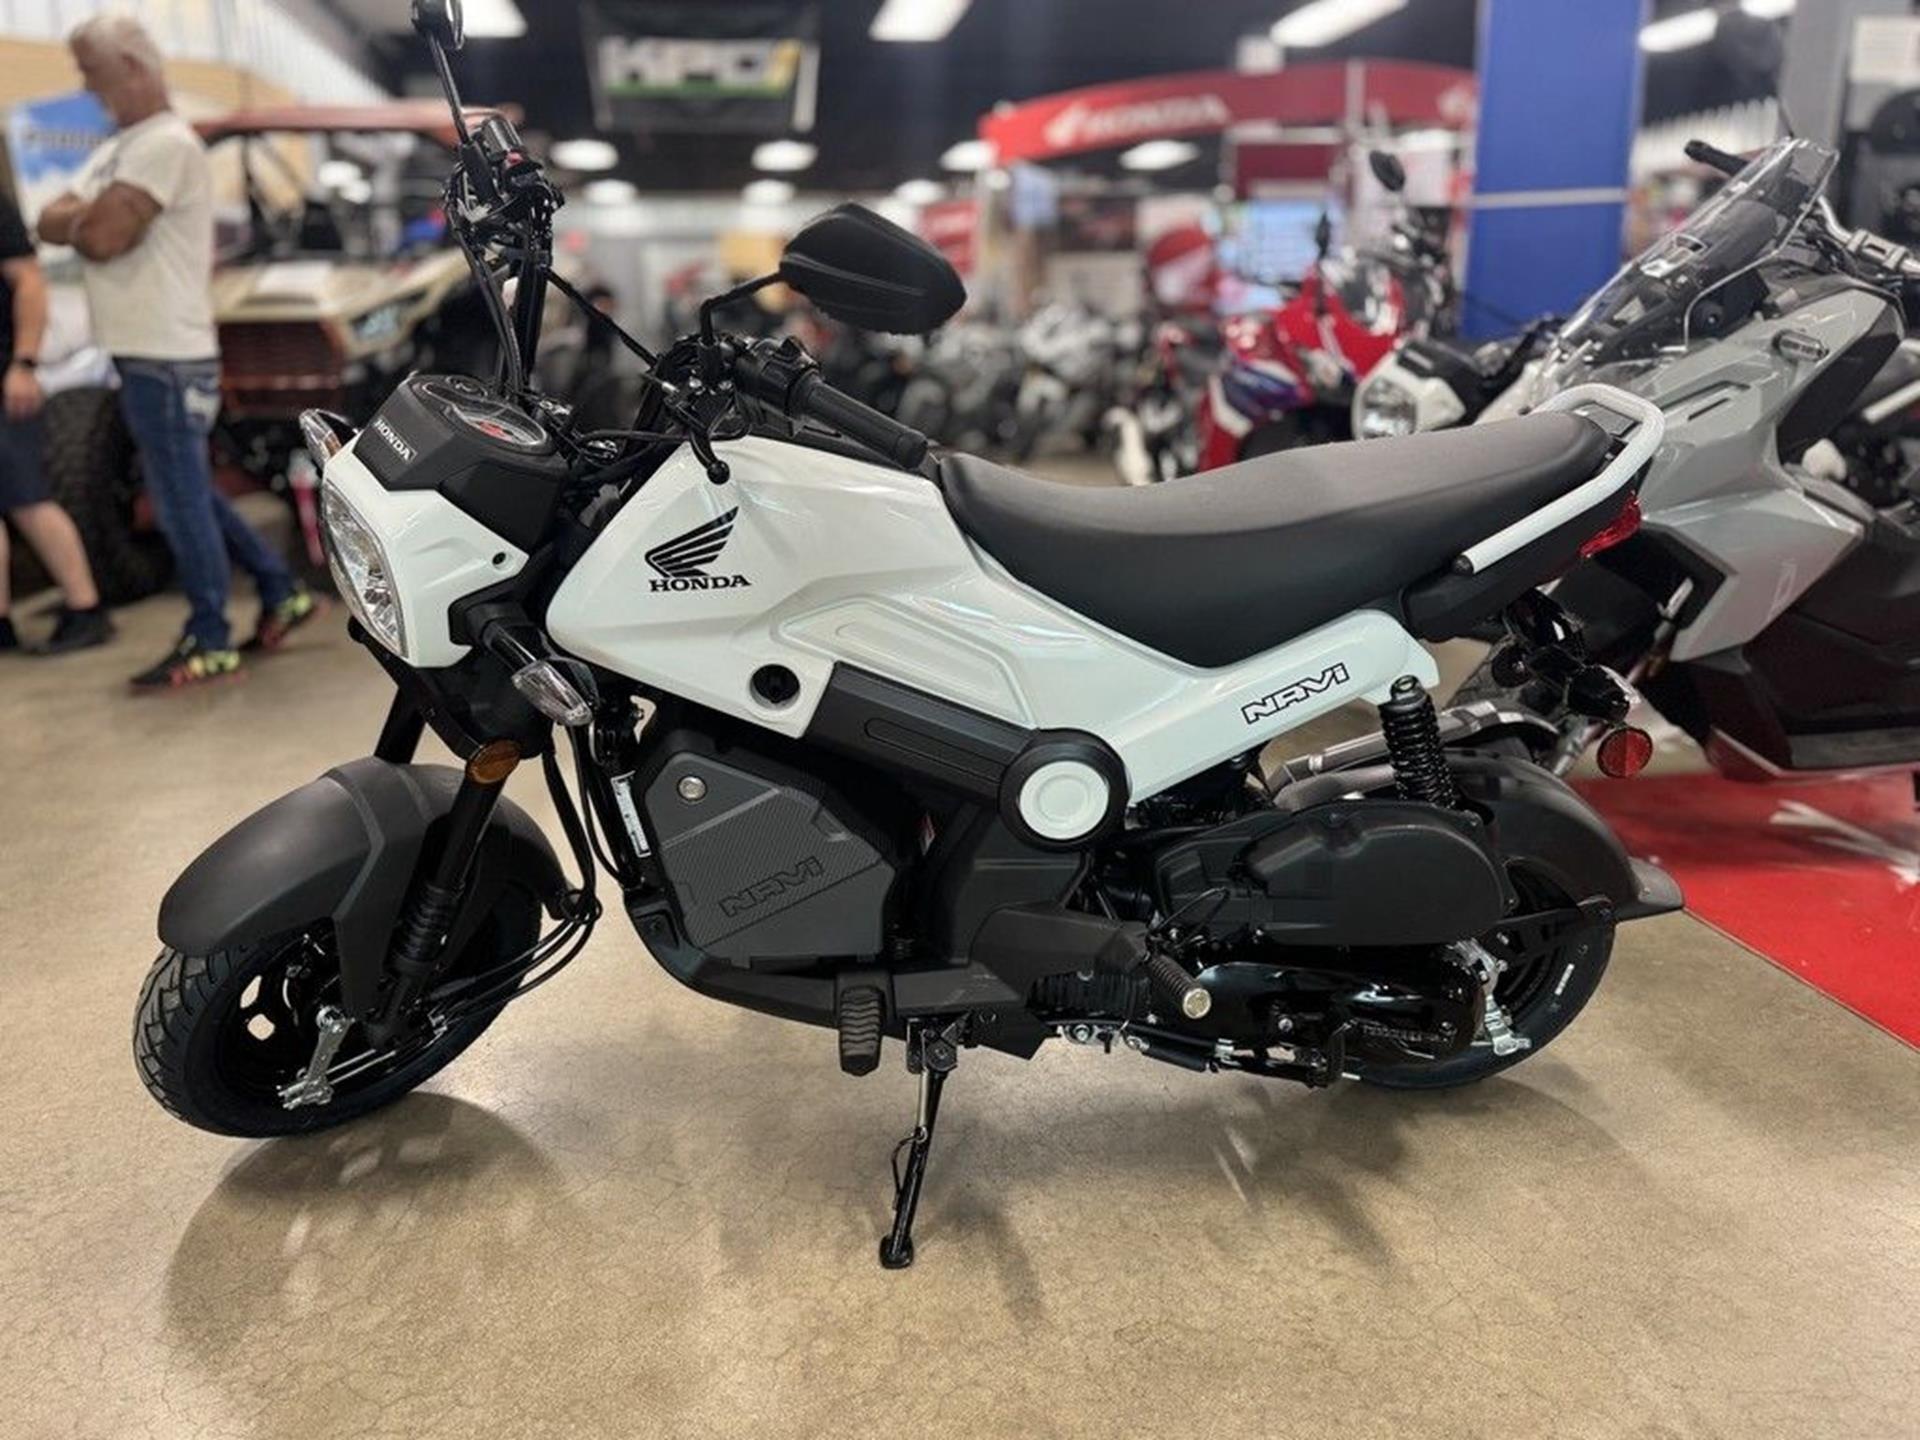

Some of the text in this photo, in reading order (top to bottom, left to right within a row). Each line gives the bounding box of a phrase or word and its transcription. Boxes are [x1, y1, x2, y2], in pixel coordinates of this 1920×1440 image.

[373, 417, 414, 461] HONDA
[648, 574, 753, 593] HONDA
[1240, 662, 1350, 725] NAVI
[718, 855, 824, 918] NAVI
